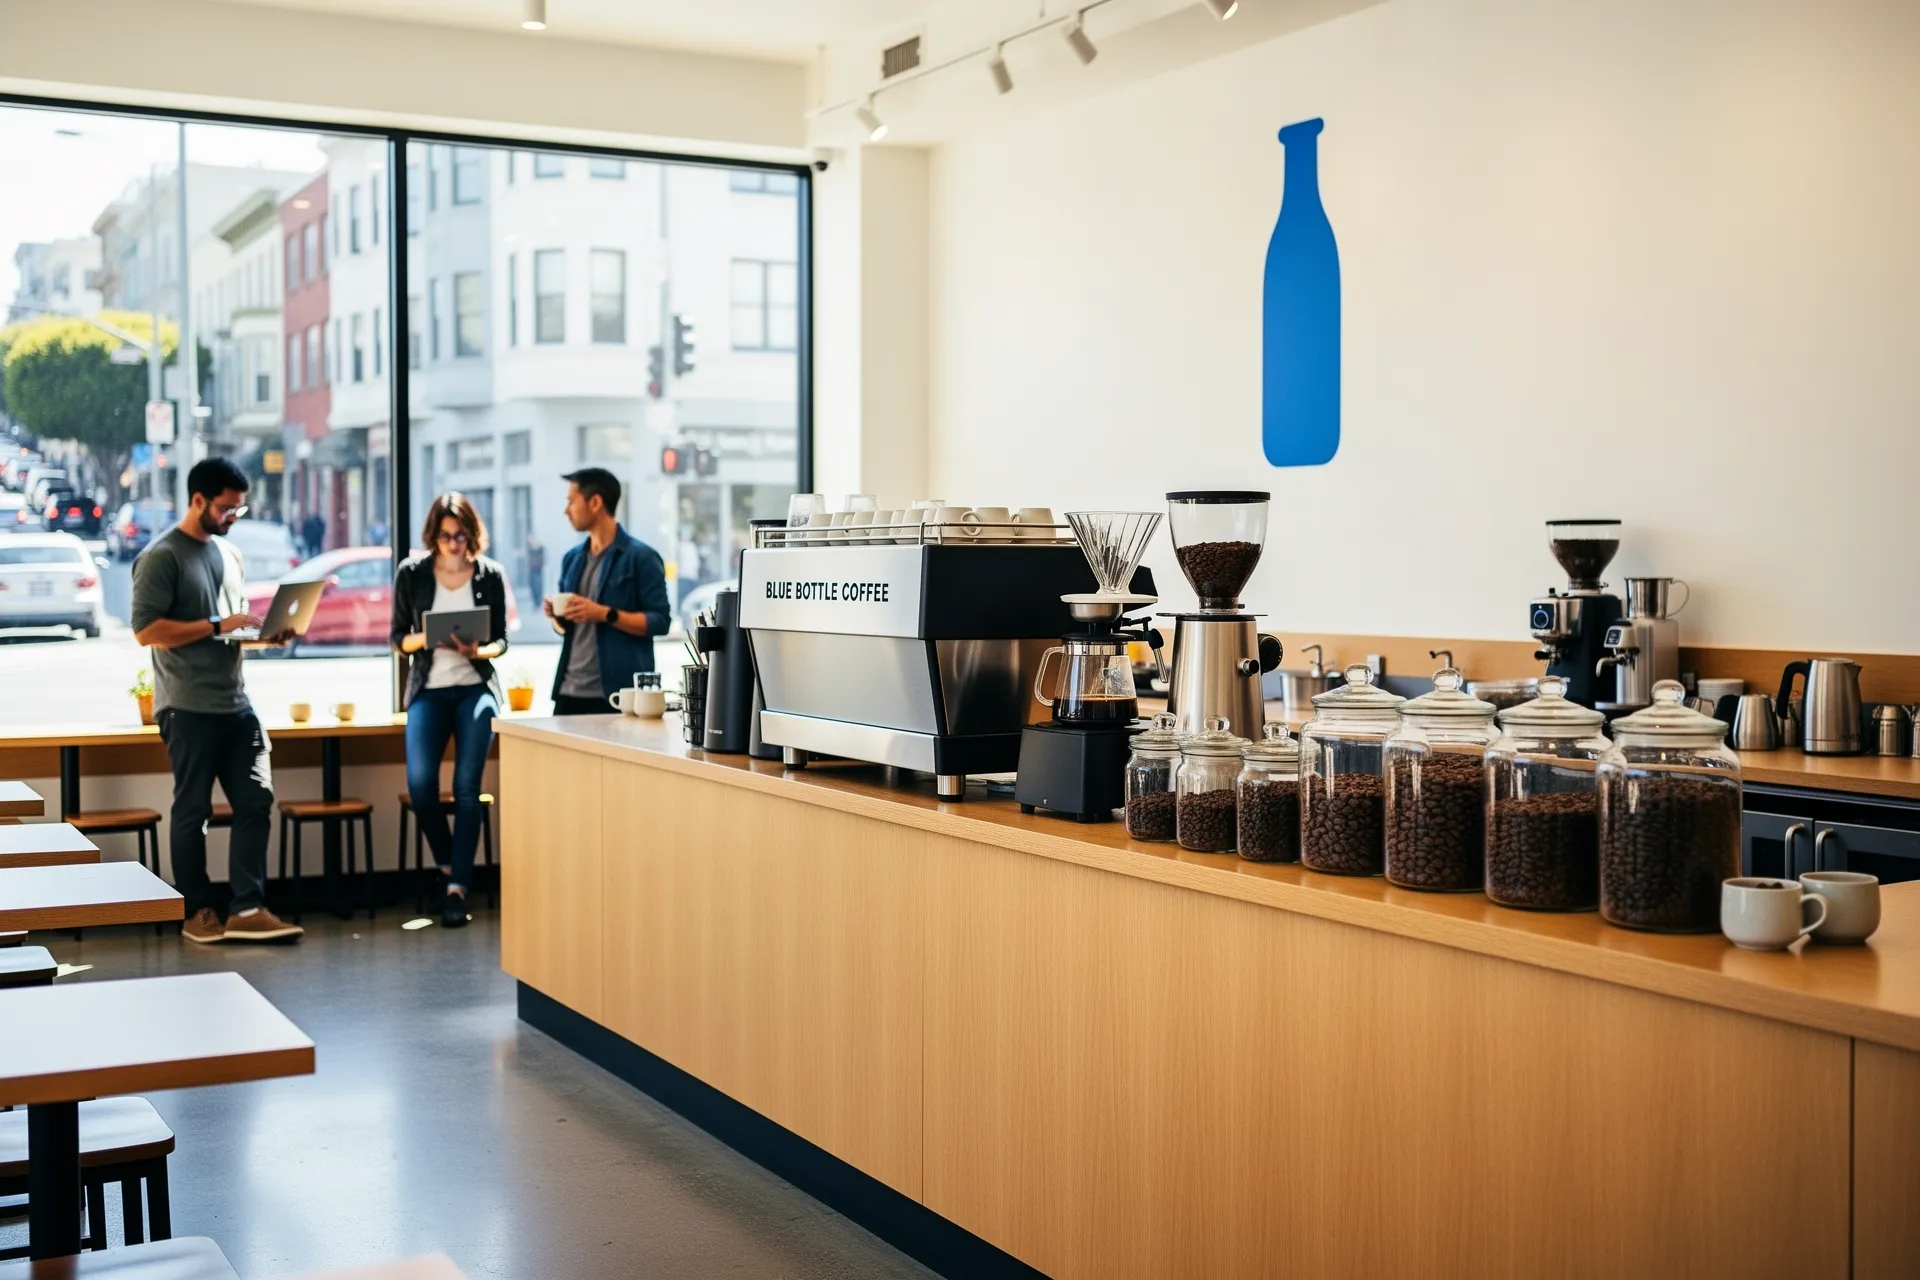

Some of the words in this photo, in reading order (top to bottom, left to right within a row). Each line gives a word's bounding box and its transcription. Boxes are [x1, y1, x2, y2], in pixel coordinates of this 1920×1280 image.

[766, 581, 792, 599] BLUE
[795, 582, 838, 600] BOTTLE
[842, 582, 889, 602] COFFEE
